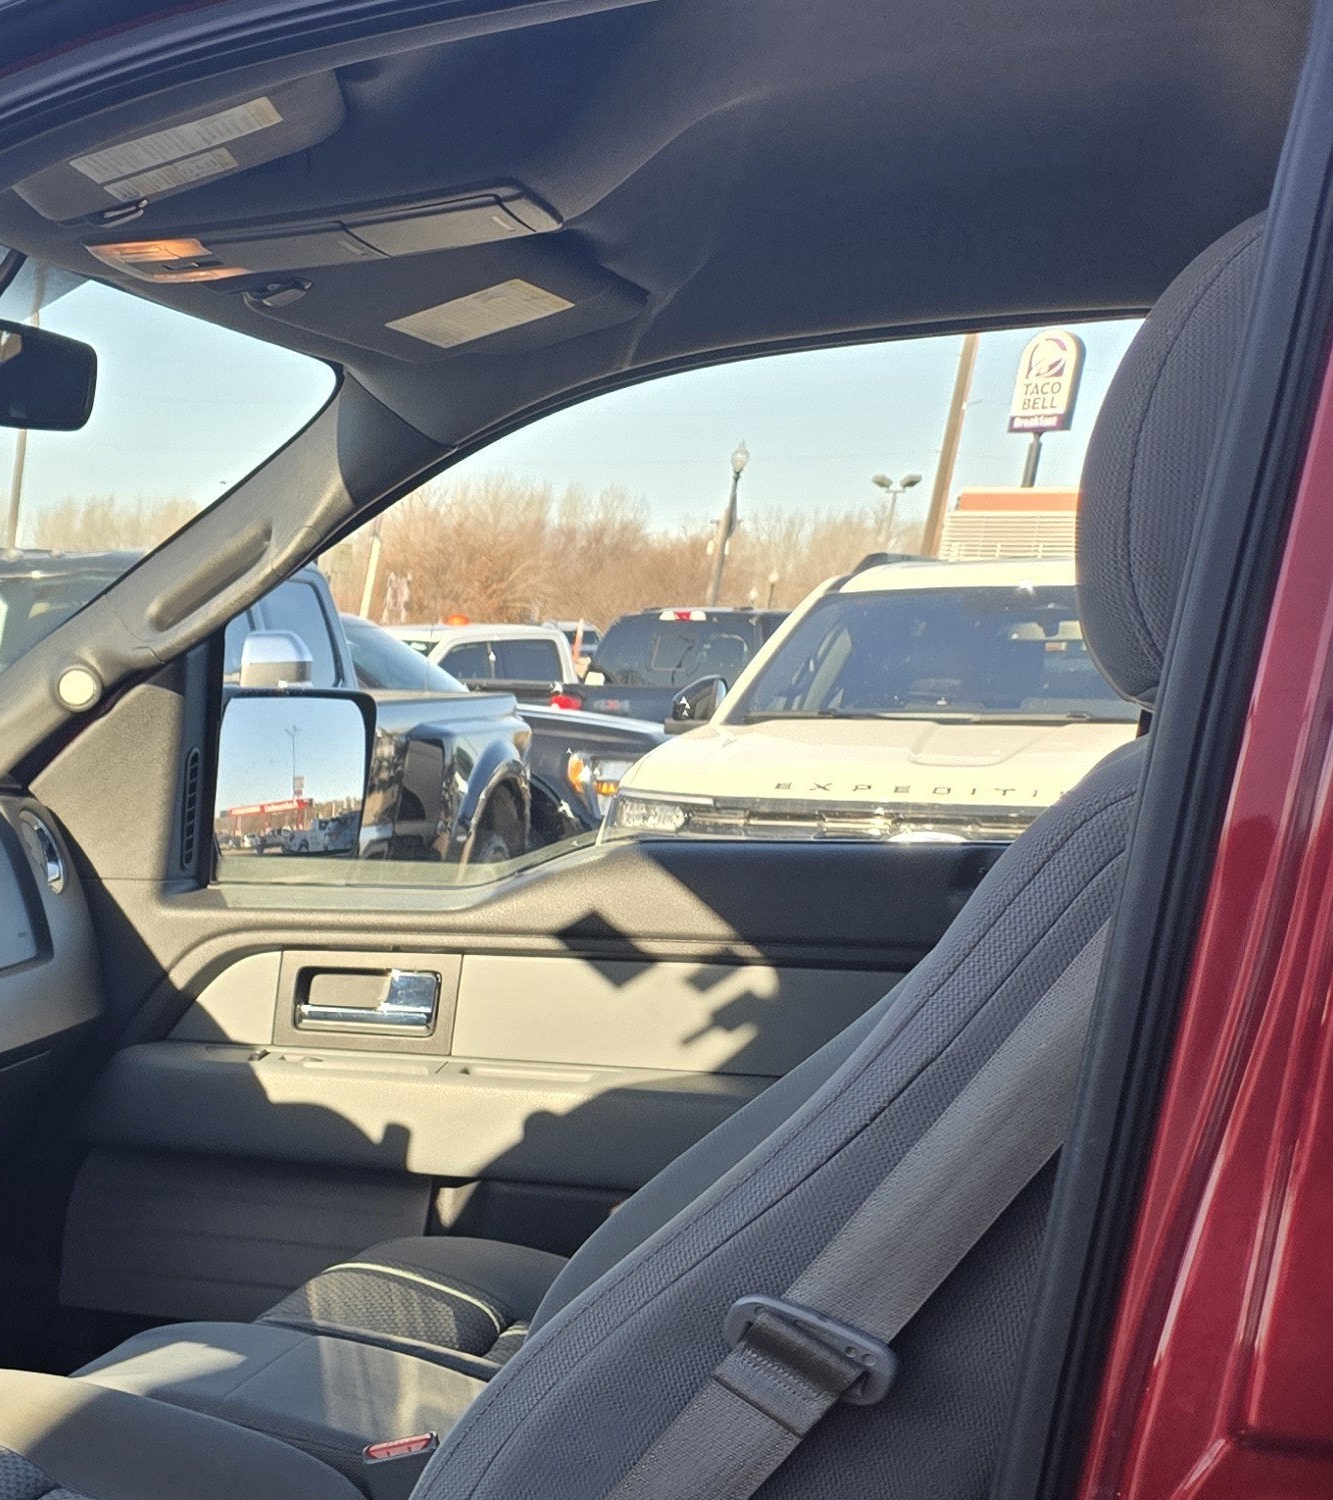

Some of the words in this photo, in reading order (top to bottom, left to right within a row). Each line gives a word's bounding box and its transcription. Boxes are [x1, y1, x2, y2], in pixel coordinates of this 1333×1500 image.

[1023, 382, 1062, 396] TACO
[1021, 397, 1057, 410] BELL
[774, 782, 1066, 797] EXPEDITI
